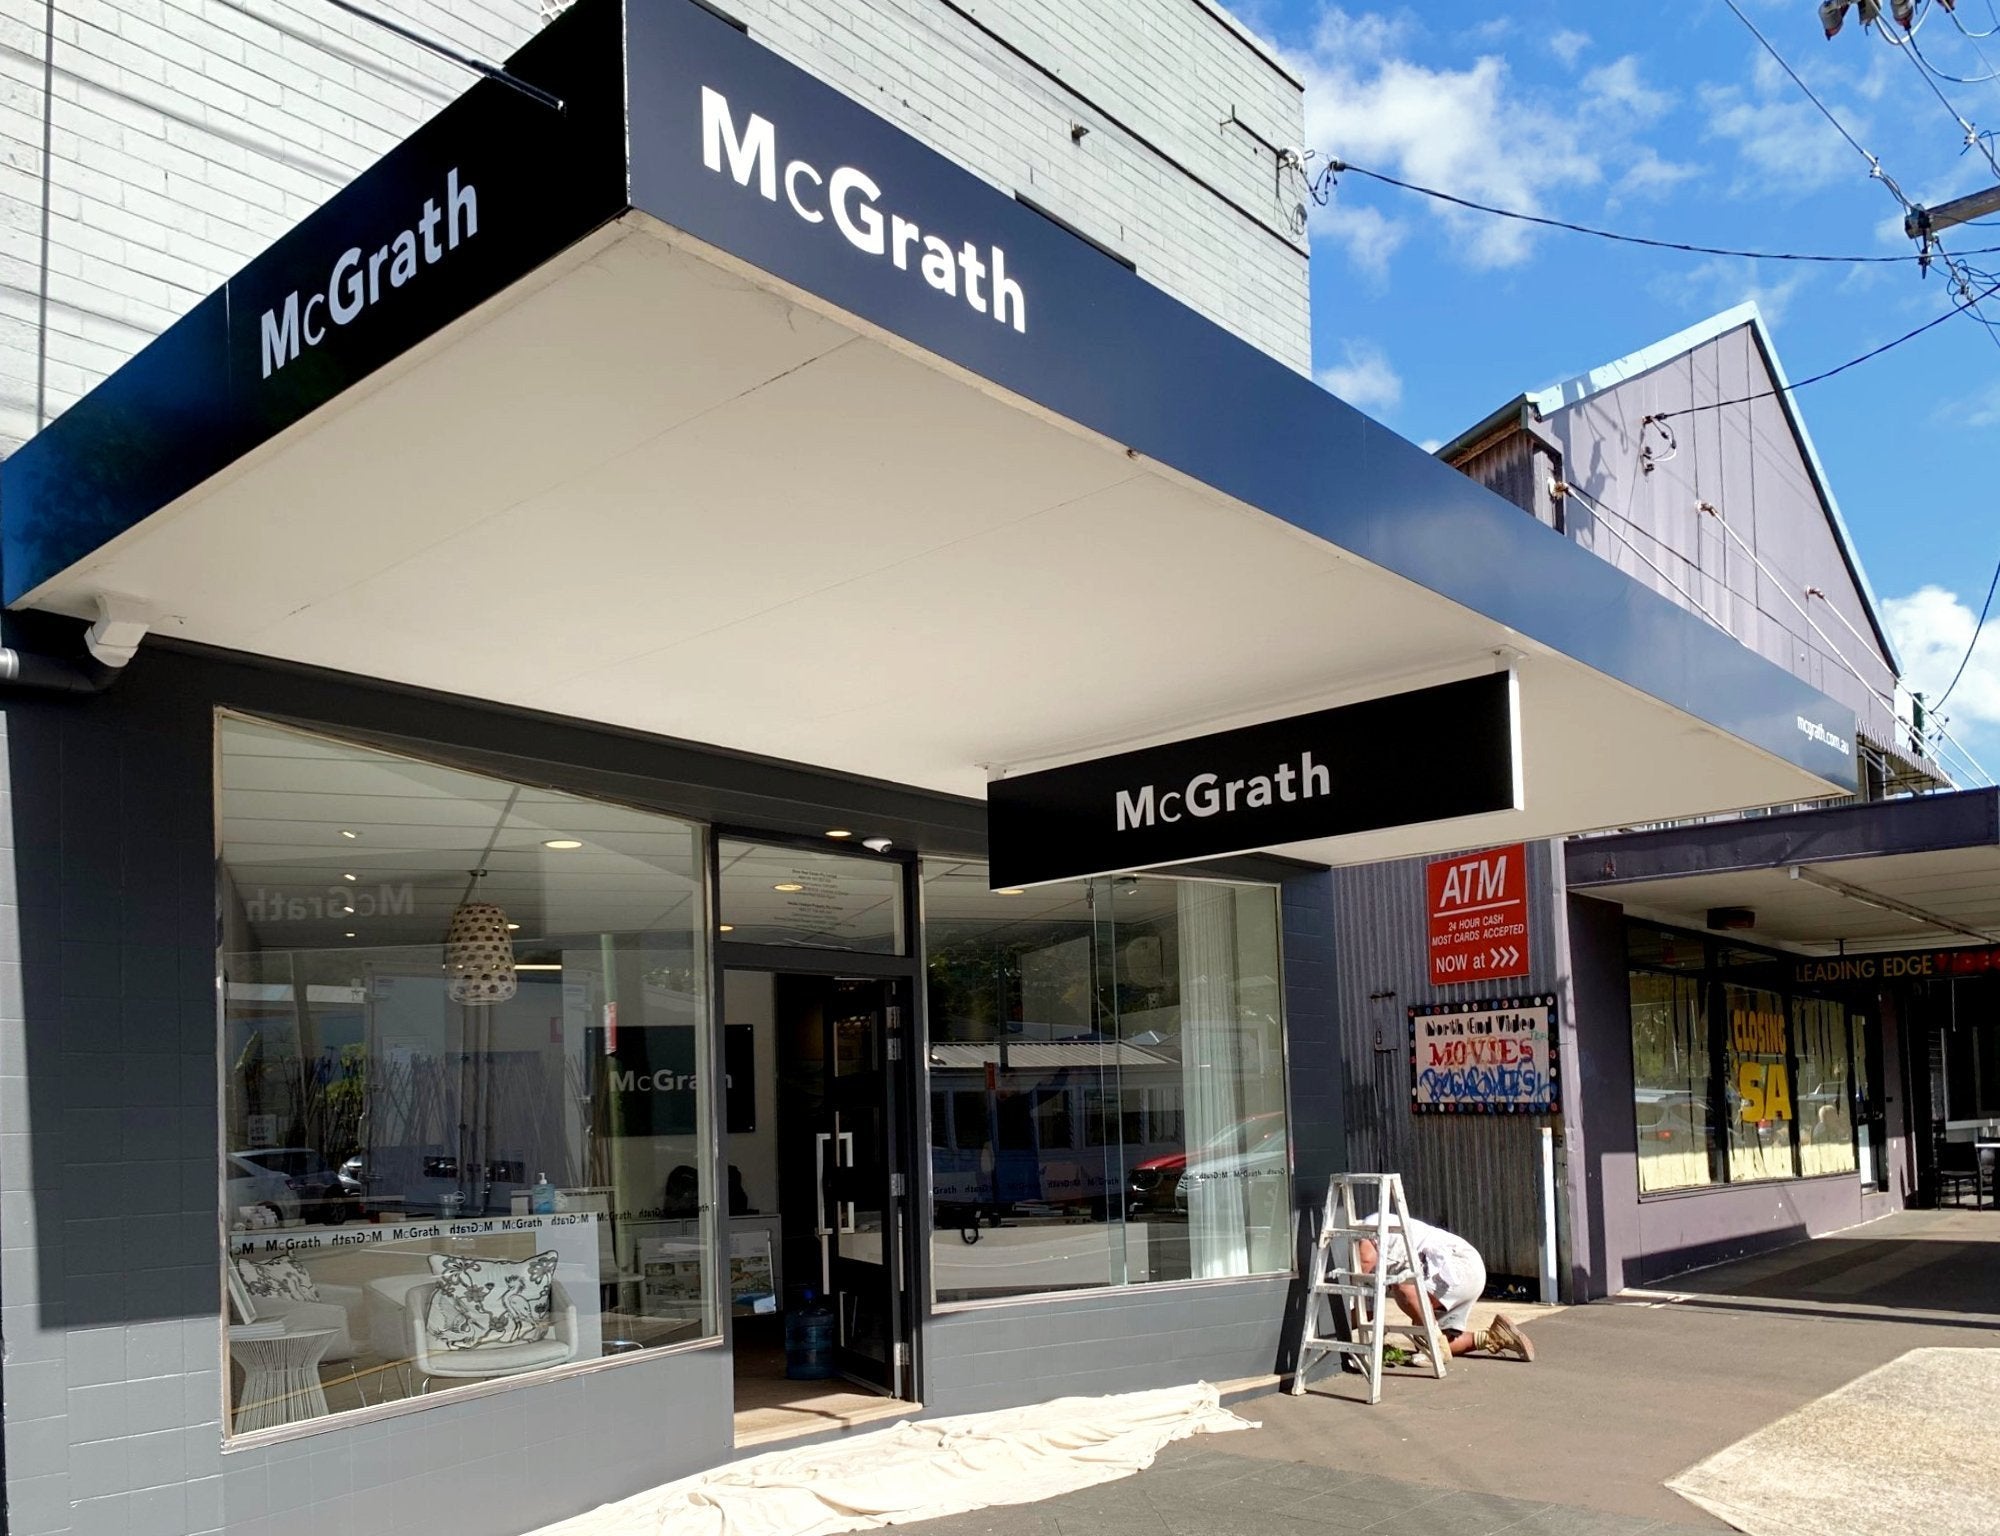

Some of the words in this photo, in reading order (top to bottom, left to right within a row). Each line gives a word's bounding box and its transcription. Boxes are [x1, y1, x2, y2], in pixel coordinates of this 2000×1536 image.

[702, 85, 1026, 334] McGrath
[261, 167, 478, 380] McGrath
[1116, 751, 1331, 831] McGrath
[1439, 855, 1507, 908] ATM
[1432, 934, 1451, 946] MOST
[1454, 930, 1480, 943] CARDS
[1483, 924, 1524, 939] ACCEPTED
[1448, 921, 1457, 932] 24
[1459, 917, 1480, 930] HOUR
[1482, 914, 1504, 926] CASH
[1436, 955, 1467, 973] NOW
[1473, 952, 1486, 969] at
[1796, 959, 1875, 982] LEADING
[1883, 955, 1933, 977] EDGE
[1425, 1018, 1464, 1037] North
[1467, 1016, 1492, 1034] End
[1499, 1013, 1535, 1033] Video
[1733, 1008, 1787, 1054] CLOSING
[1429, 1037, 1534, 1066] MOVIES
[393, 1226, 440, 1240] McGrath
[502, 1218, 542, 1230] McGrath
[266, 1236, 321, 1252] McGrath
